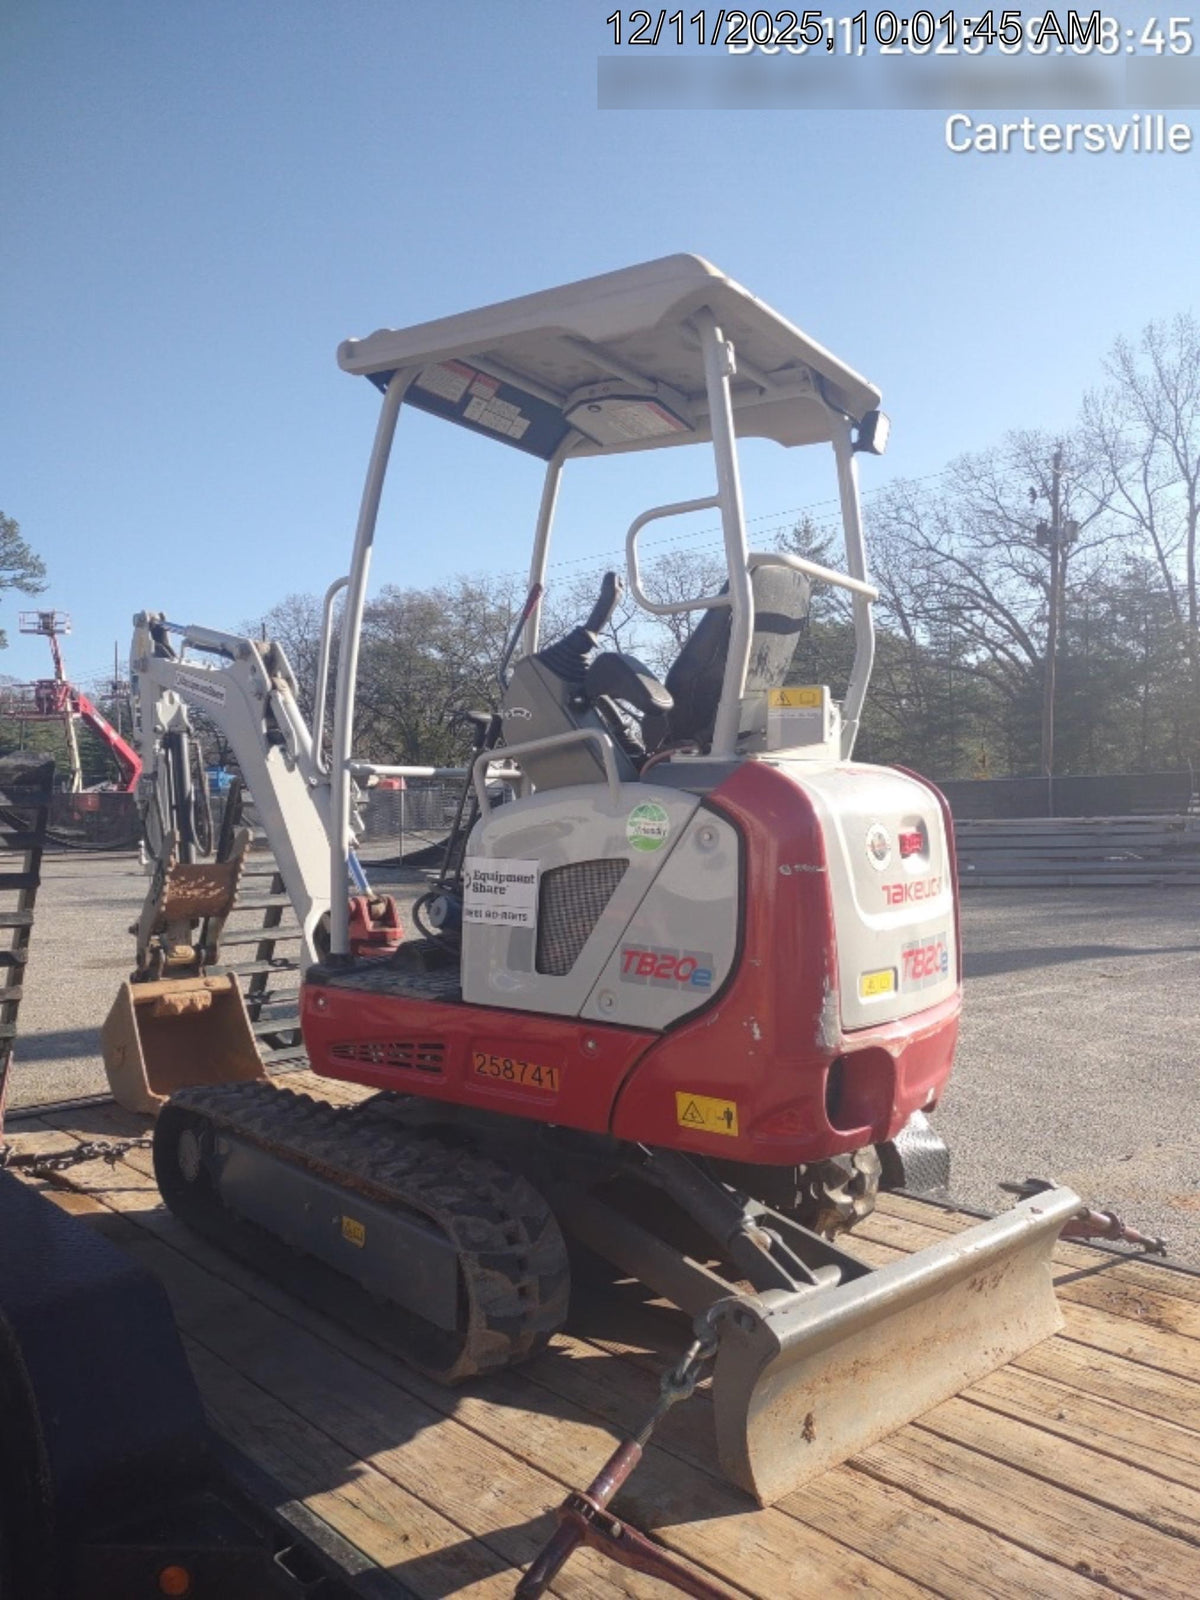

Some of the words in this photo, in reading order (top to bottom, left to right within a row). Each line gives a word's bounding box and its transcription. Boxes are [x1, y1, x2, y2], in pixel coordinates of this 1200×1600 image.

[472, 869, 535, 884] Equipment
[472, 881, 507, 895] Share
[622, 948, 712, 987] TB20e
[475, 1053, 556, 1088] 258741
